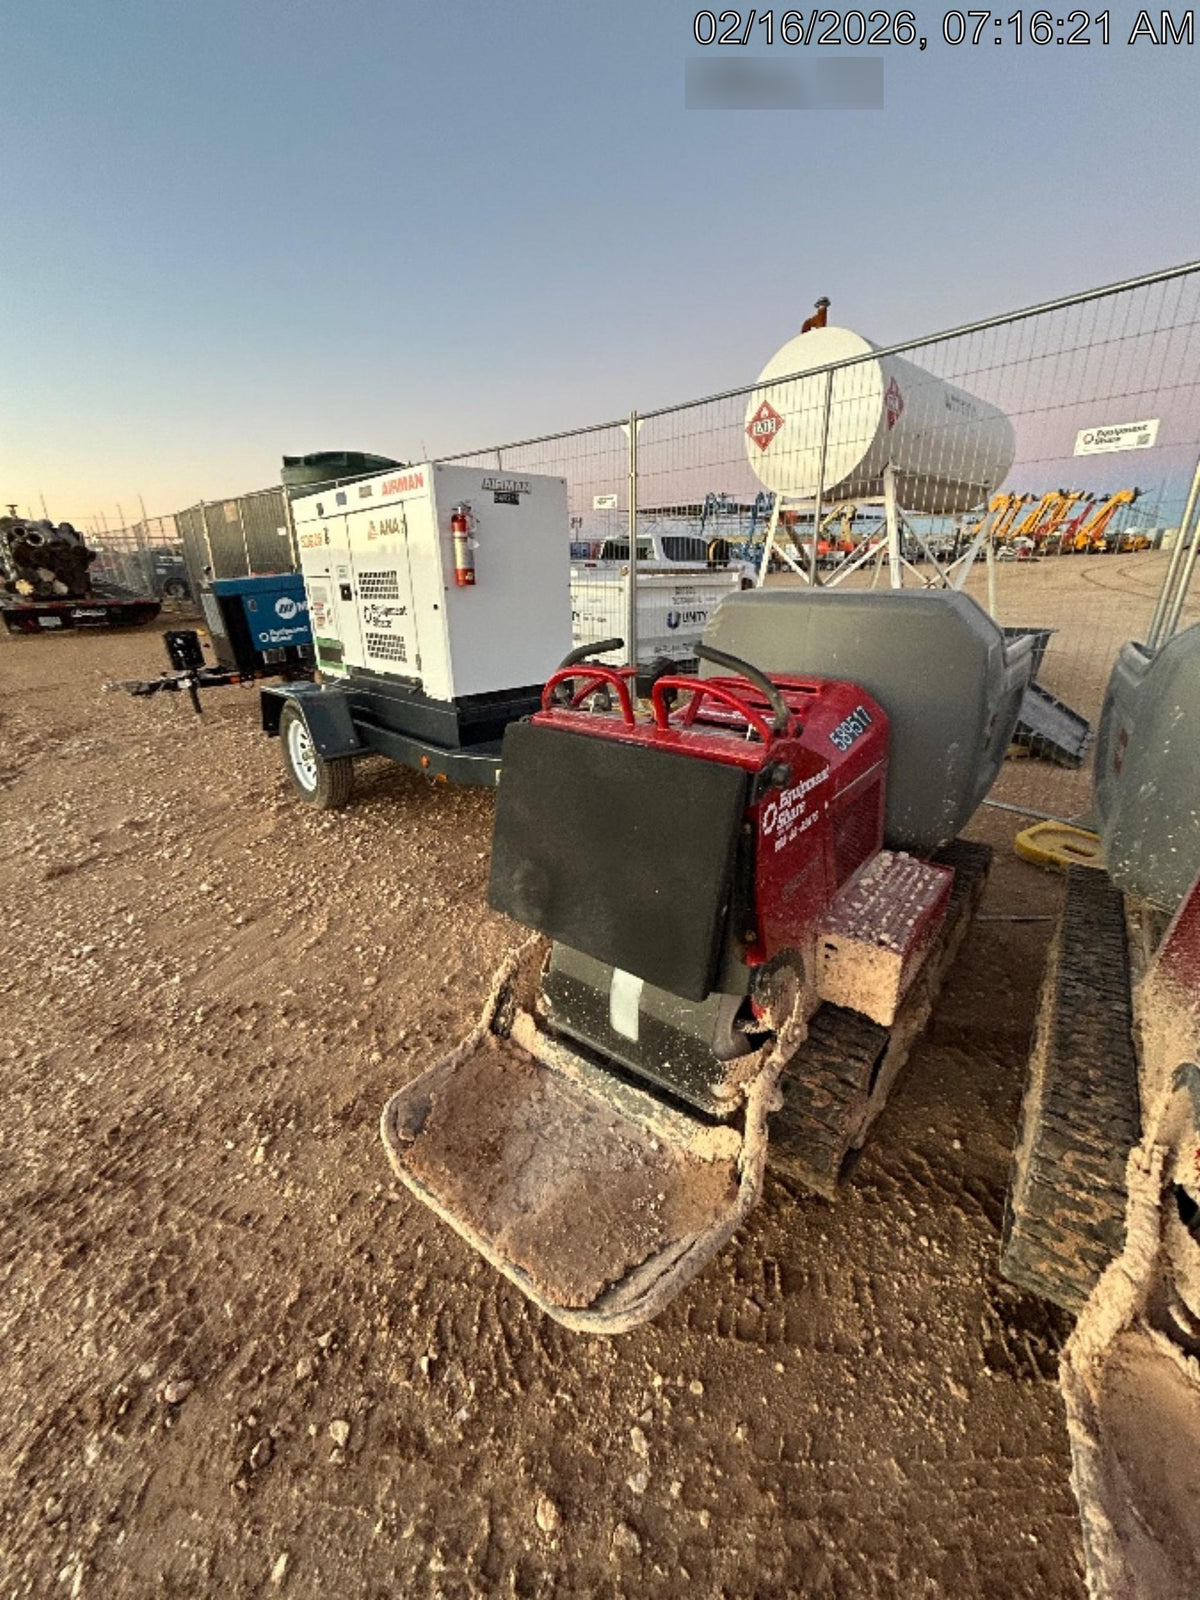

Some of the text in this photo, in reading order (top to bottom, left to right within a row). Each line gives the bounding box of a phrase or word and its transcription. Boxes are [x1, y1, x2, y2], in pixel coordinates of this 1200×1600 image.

[381, 471, 425, 496] AIRMAN
[828, 705, 873, 752] 589517
[777, 764, 831, 810] Equipment
[775, 799, 806, 830] Share
